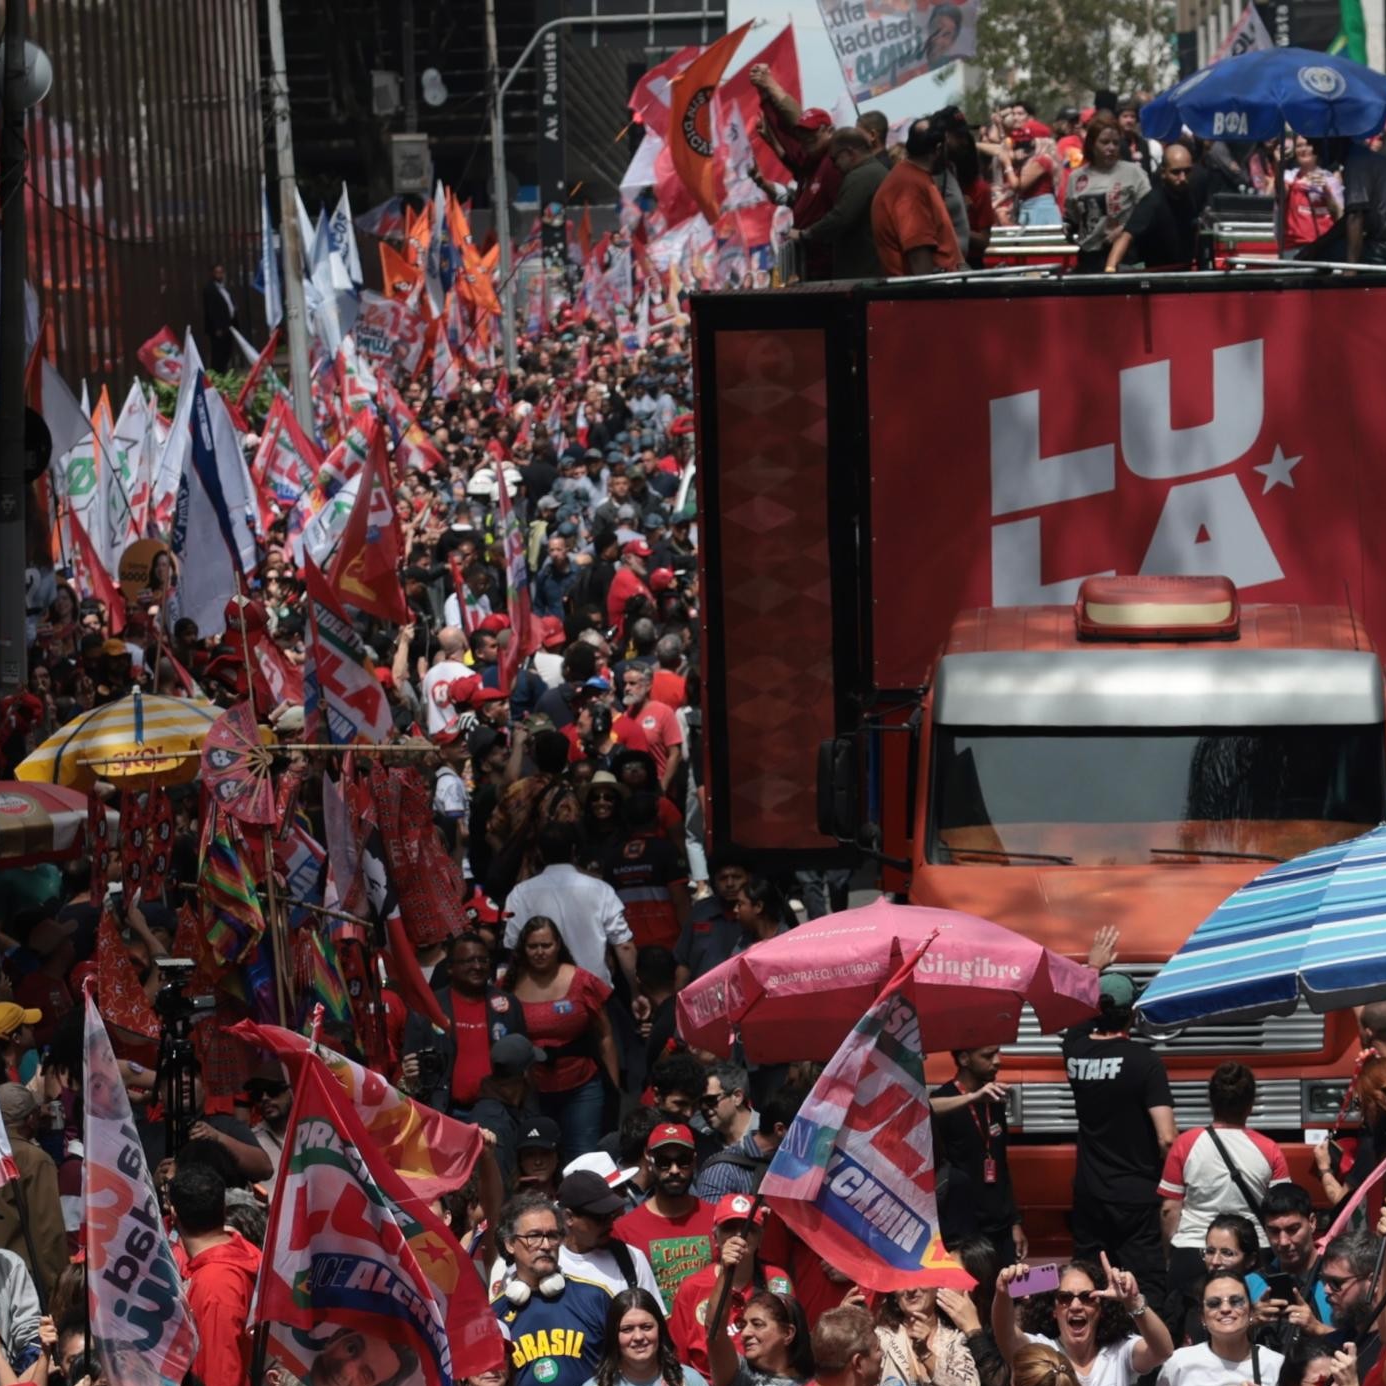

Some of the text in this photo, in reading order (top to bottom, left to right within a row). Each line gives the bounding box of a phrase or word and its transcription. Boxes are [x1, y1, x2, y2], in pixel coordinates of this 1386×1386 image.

[542, 31, 558, 140] Av. Paulista
[113, 746, 165, 771] SKOL
[917, 953, 1021, 982] Gingibre
[1066, 1057, 1124, 1081] STAFF
[824, 1152, 926, 1251] LCKMIN
[513, 1328, 585, 1368] BRASIL
